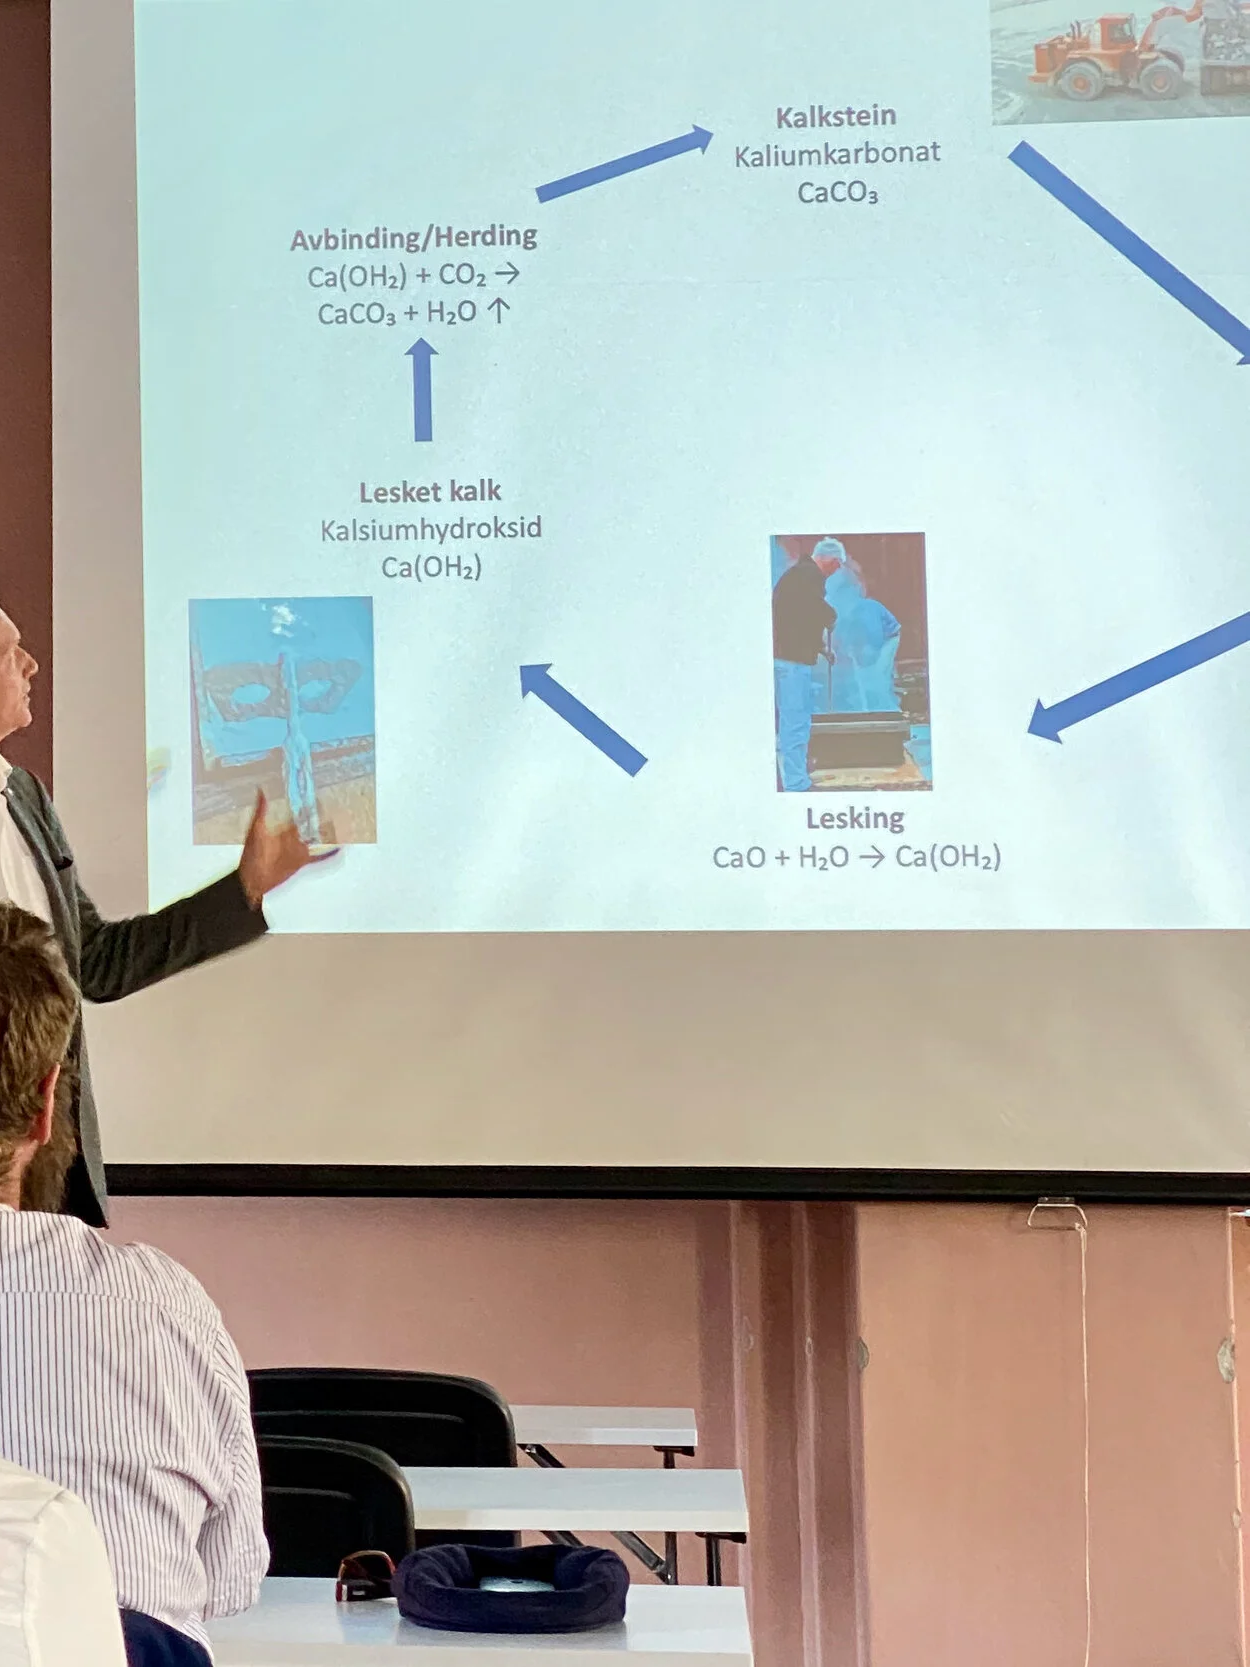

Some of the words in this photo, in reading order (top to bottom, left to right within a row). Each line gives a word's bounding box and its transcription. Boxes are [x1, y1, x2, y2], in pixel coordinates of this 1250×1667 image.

[776, 103, 897, 130] Kalkstein
[735, 140, 942, 168] Kaliumkarbonat
[289, 223, 538, 255] Avbinding/Herding
[360, 479, 442, 504] Lesket
[450, 478, 502, 502] kalk
[321, 514, 542, 546] Kalsiumhydroksid
[806, 805, 906, 835] Lesking
[712, 845, 766, 869] CaO
